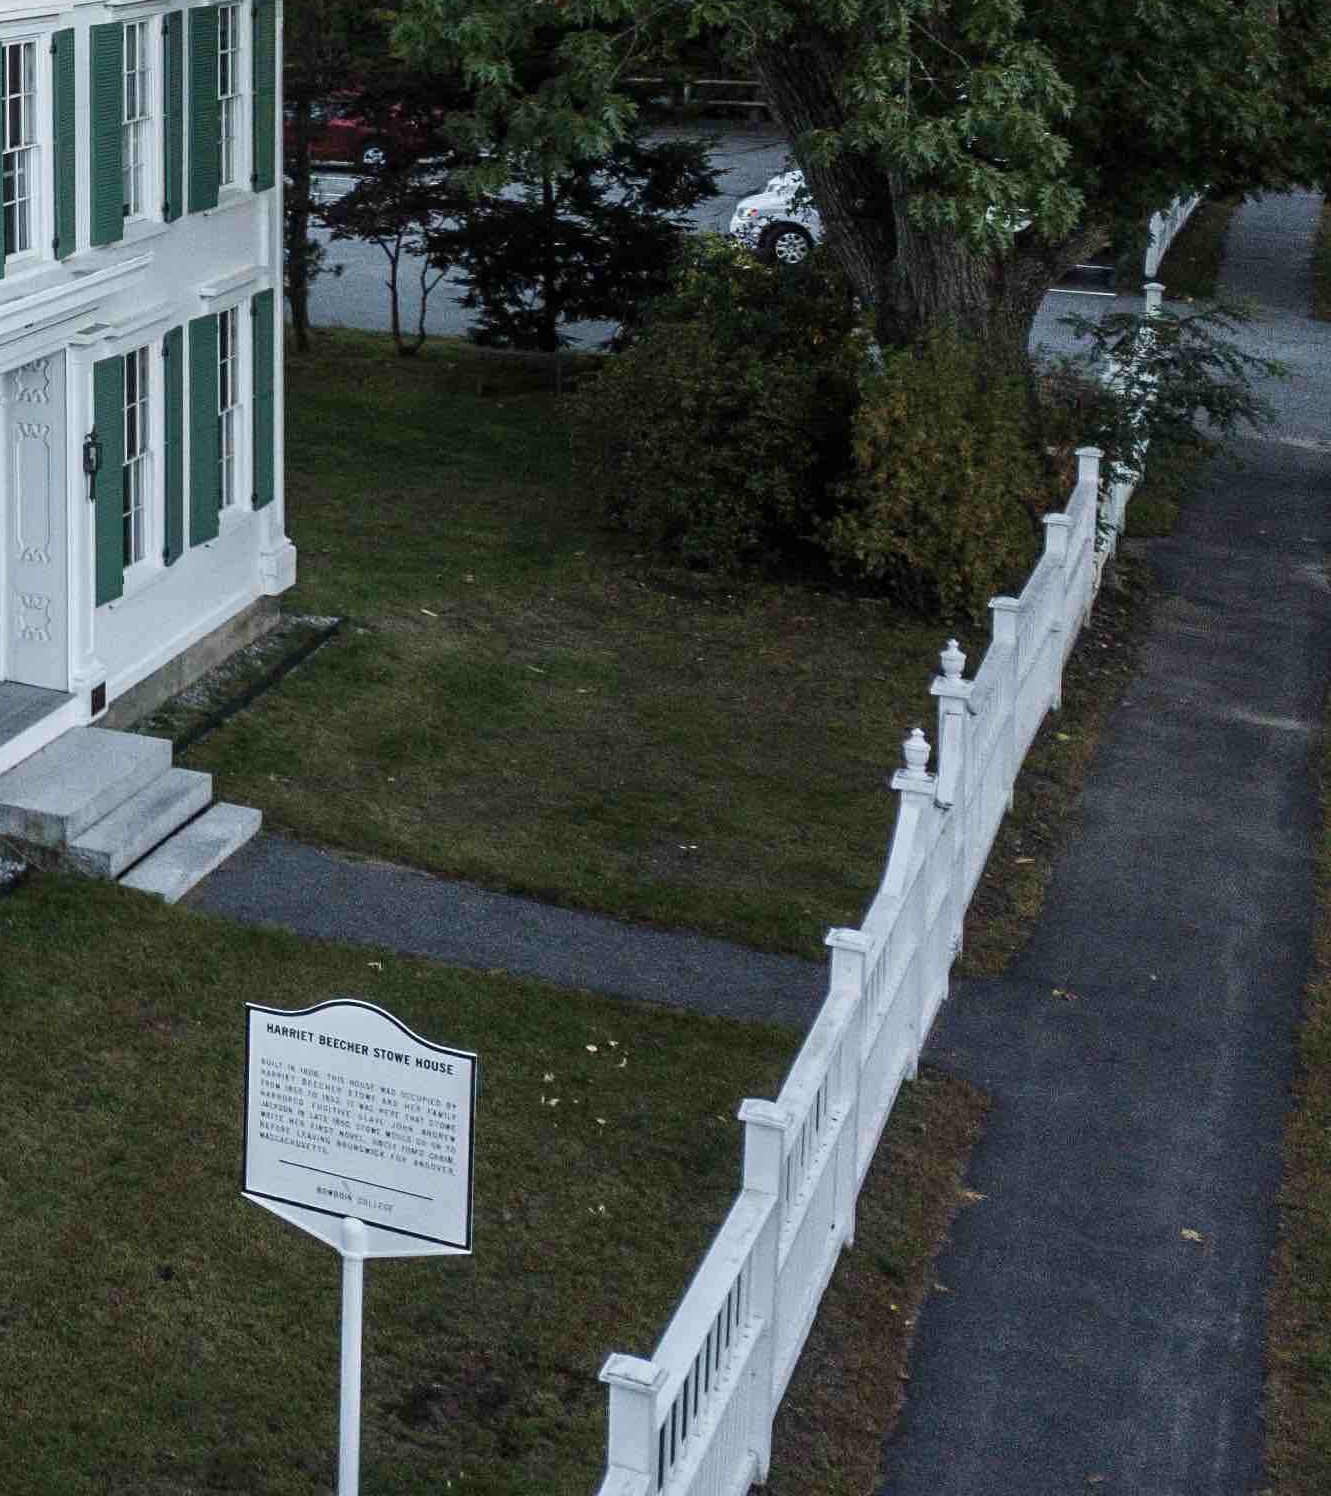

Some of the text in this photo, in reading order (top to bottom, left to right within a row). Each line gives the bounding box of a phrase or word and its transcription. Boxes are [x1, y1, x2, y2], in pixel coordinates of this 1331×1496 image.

[267, 1023, 454, 1075] HARRIET BEECHER STOWE HOUSE
[327, 1073, 344, 1084] THIS
[349, 1078, 374, 1091] HOUSE
[316, 1186, 393, 1212] BOWDOIN COLLEGE
